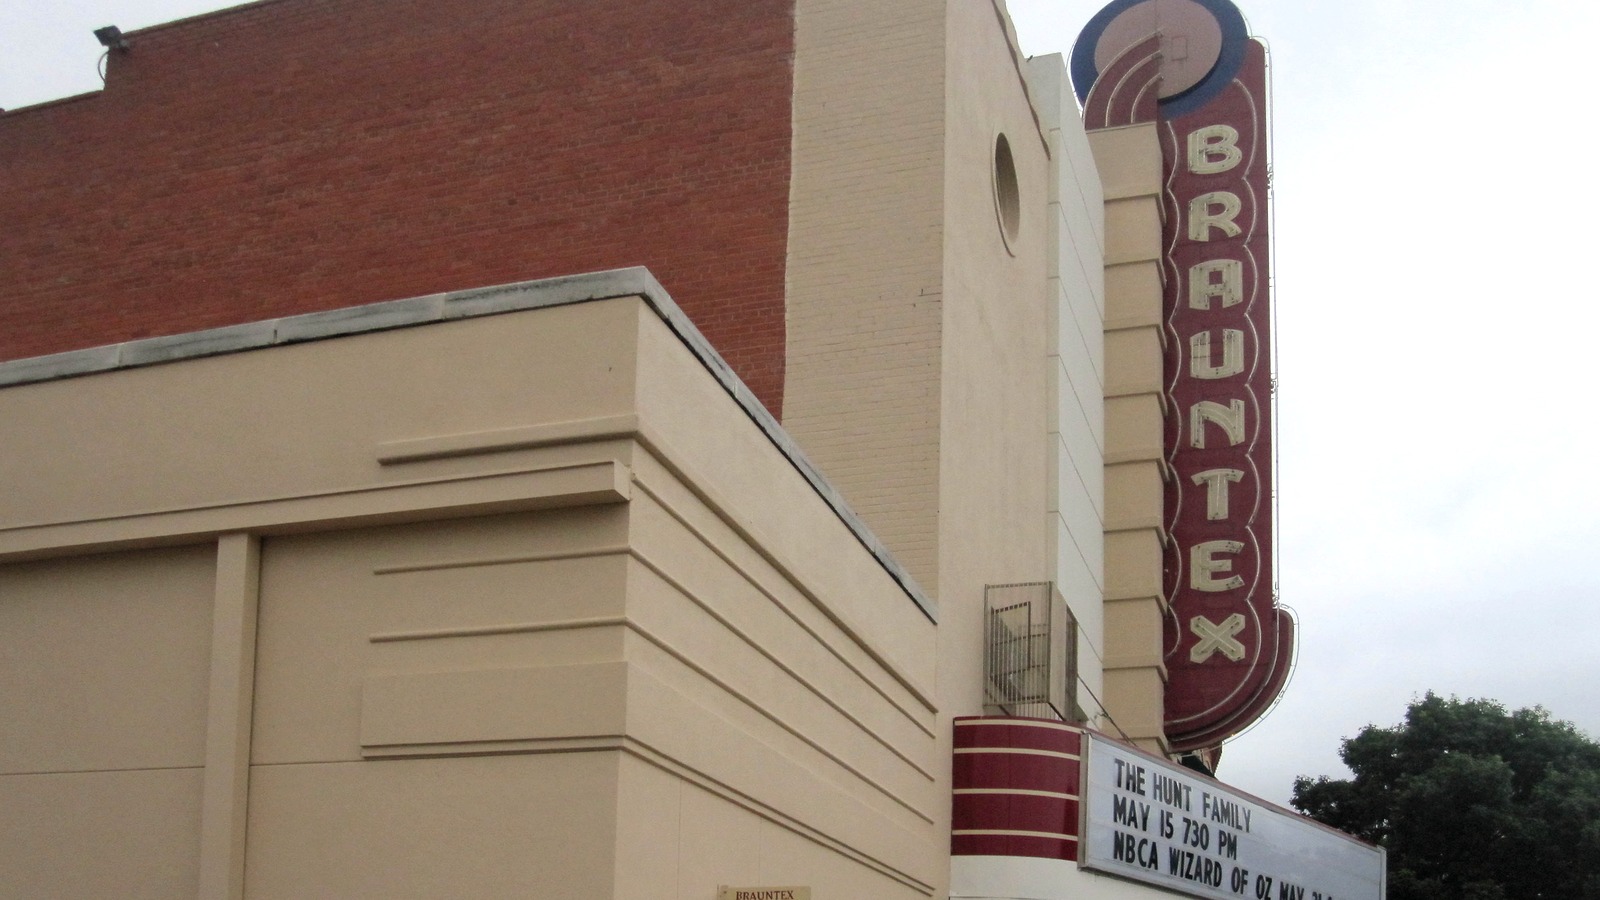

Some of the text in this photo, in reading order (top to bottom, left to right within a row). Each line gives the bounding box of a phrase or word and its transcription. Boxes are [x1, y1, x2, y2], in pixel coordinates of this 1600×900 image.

[1187, 124, 1246, 664] BRAUNTEX
[1113, 794, 1238, 861] MAY 15 730 PM
[1115, 758, 1251, 833] THE HUNT FAMILY
[736, 890, 794, 900] BRAUNTEX
[1113, 831, 1158, 870] NBCA
[1169, 847, 1223, 888] WIZARD
[1231, 866, 1248, 895] OF
[1256, 874, 1272, 900] OZ
